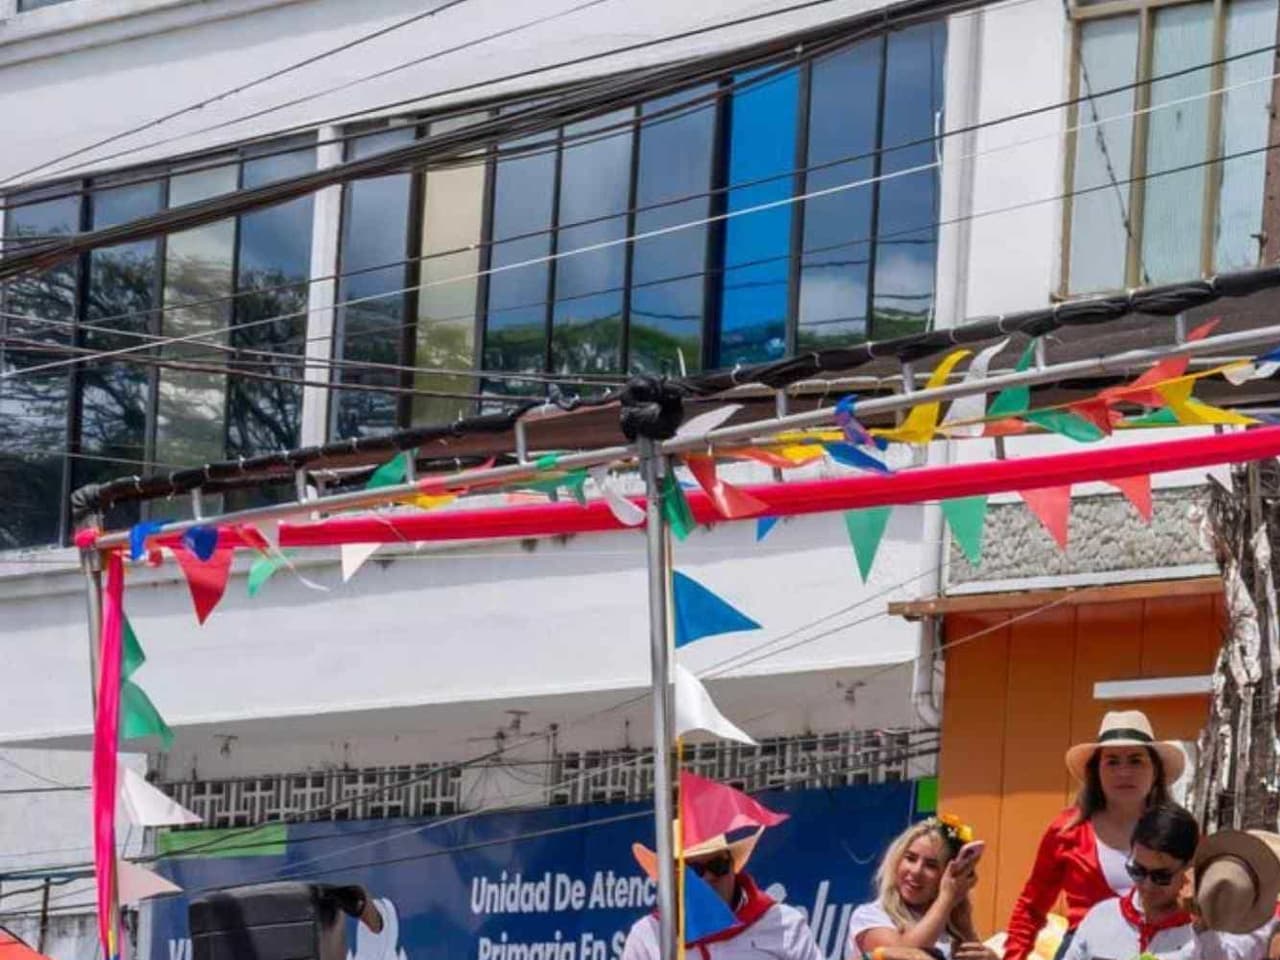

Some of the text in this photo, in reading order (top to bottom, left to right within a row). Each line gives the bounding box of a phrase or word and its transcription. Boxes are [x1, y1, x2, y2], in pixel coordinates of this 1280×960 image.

[471, 870, 657, 914] Unidad De Atenc
